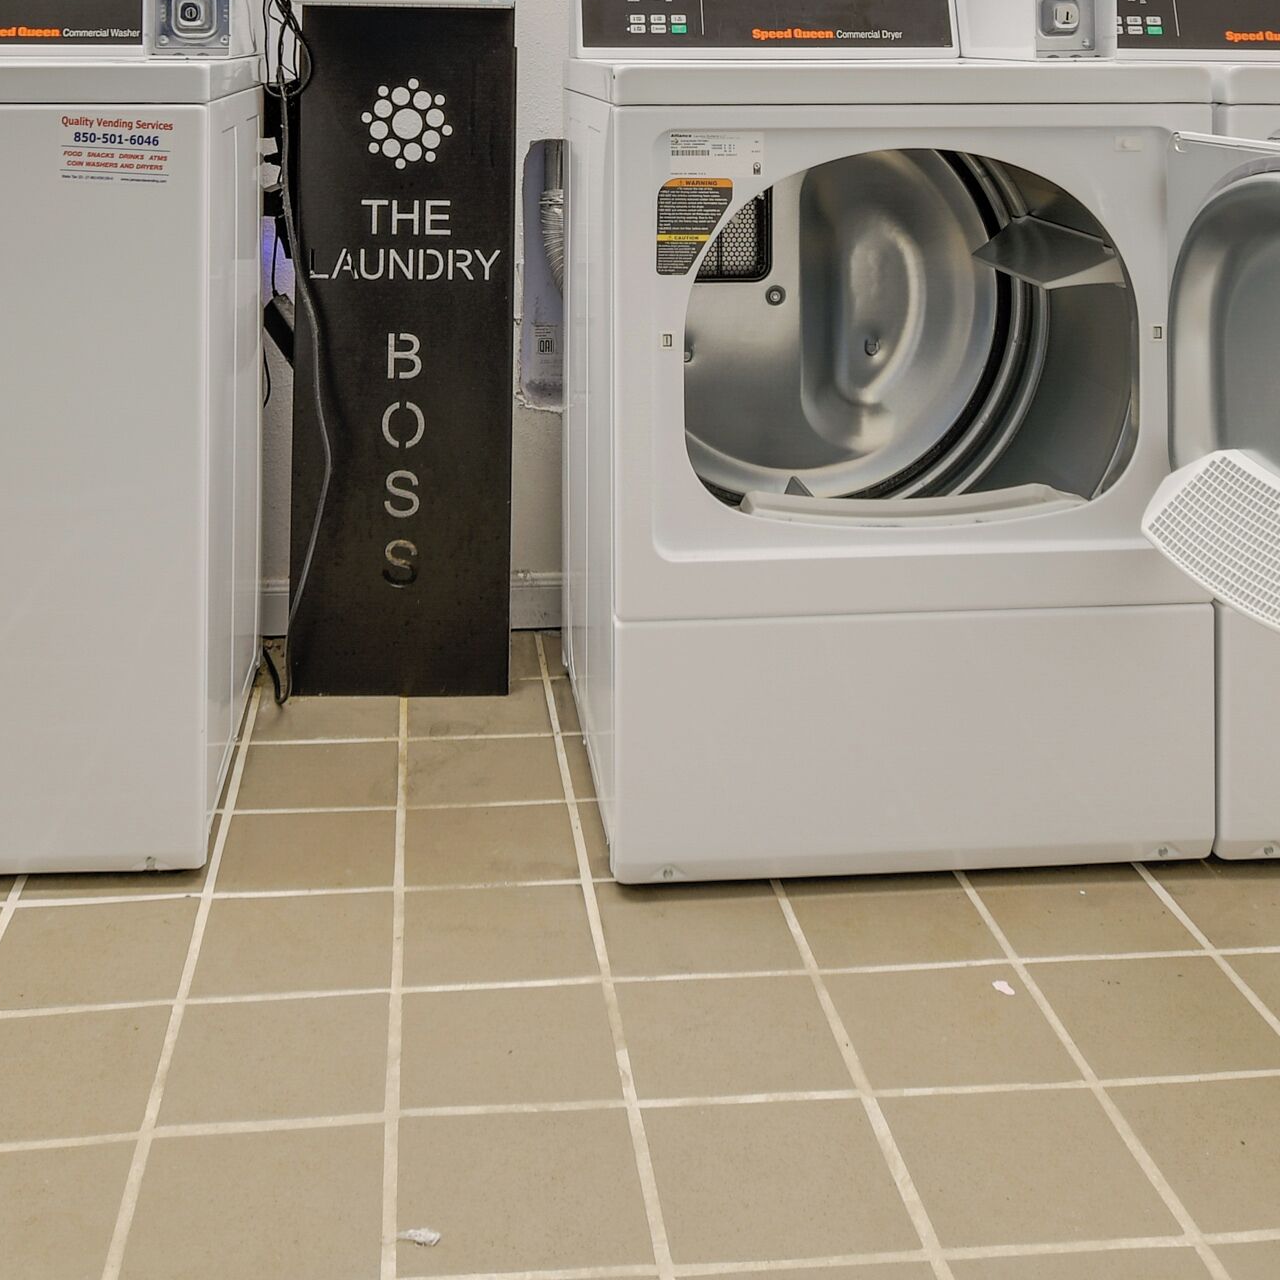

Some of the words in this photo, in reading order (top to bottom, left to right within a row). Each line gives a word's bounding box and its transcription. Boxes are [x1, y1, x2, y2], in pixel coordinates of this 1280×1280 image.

[17, 26, 61, 37] Queen
[62, 28, 109, 37] Commercial
[110, 28, 141, 37] Washer
[752, 28, 792, 40] Speed
[793, 28, 834, 39] Queen
[836, 30, 880, 39] Commercial
[881, 30, 903, 40] Dryer
[1225, 31, 1264, 42] Speed
[61, 116, 94, 128] Quality
[96, 118, 133, 130] Vending
[135, 120, 173, 130] Services
[73, 132, 160, 146] 850-501-6046
[136, 163, 163, 171] DRYERS
[361, 199, 451, 235] THE
[309, 248, 501, 282] LAUNDRY
[381, 332, 425, 589] BOSS
